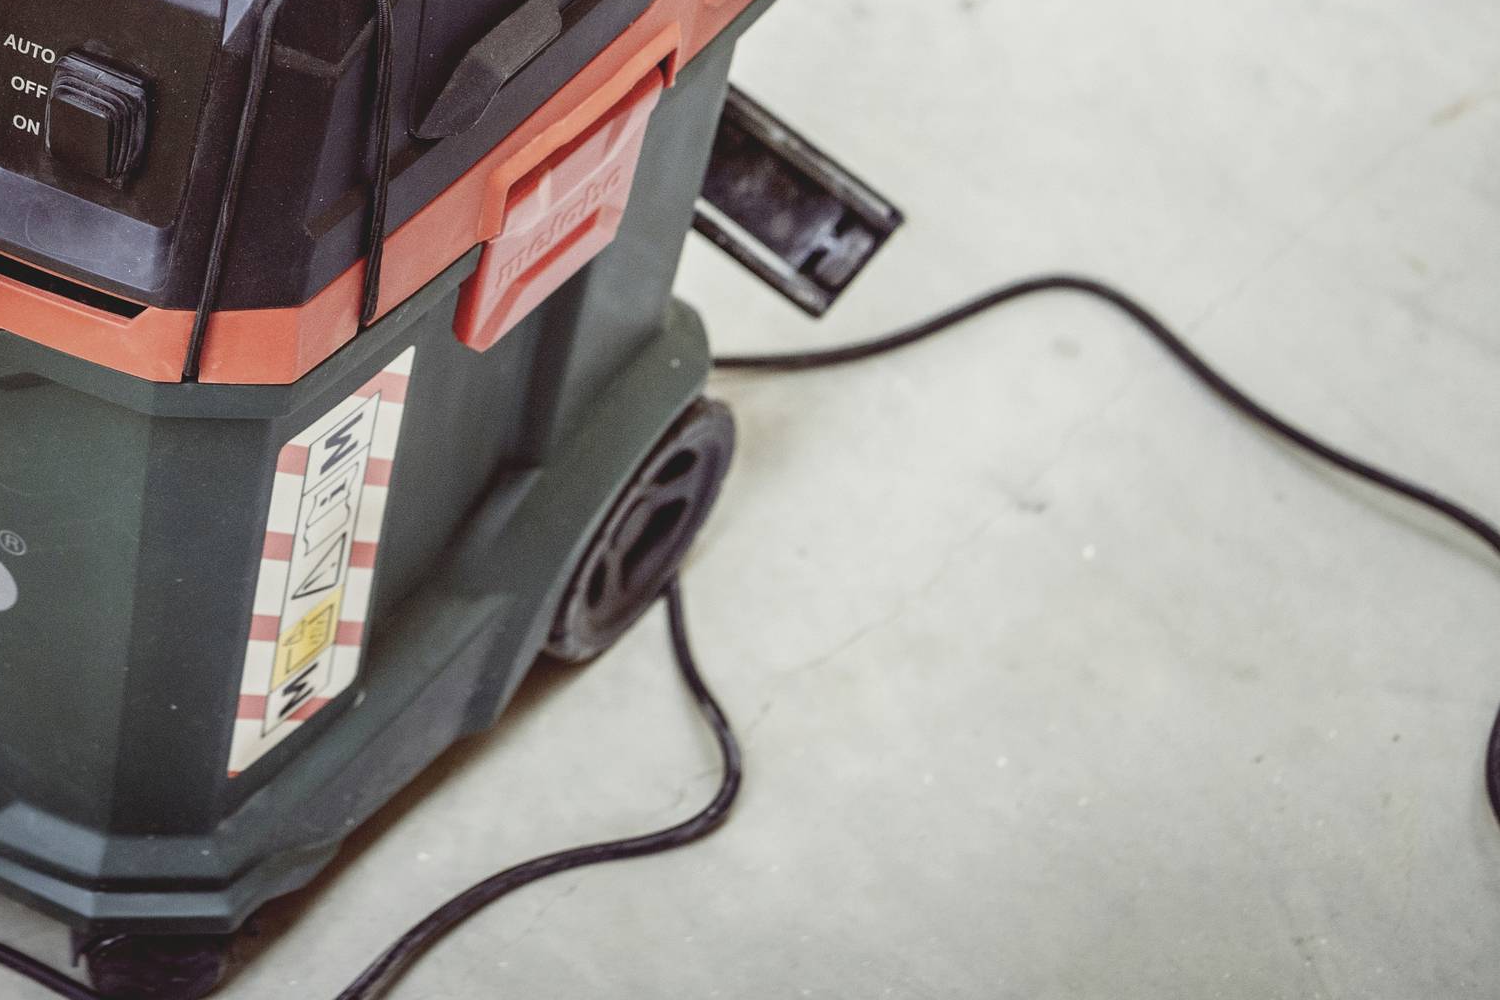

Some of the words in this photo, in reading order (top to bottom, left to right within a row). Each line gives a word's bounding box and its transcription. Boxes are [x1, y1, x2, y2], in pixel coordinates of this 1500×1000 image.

[3, 33, 56, 64] AUTO
[10, 75, 48, 99] OFF
[12, 114, 41, 136] ON
